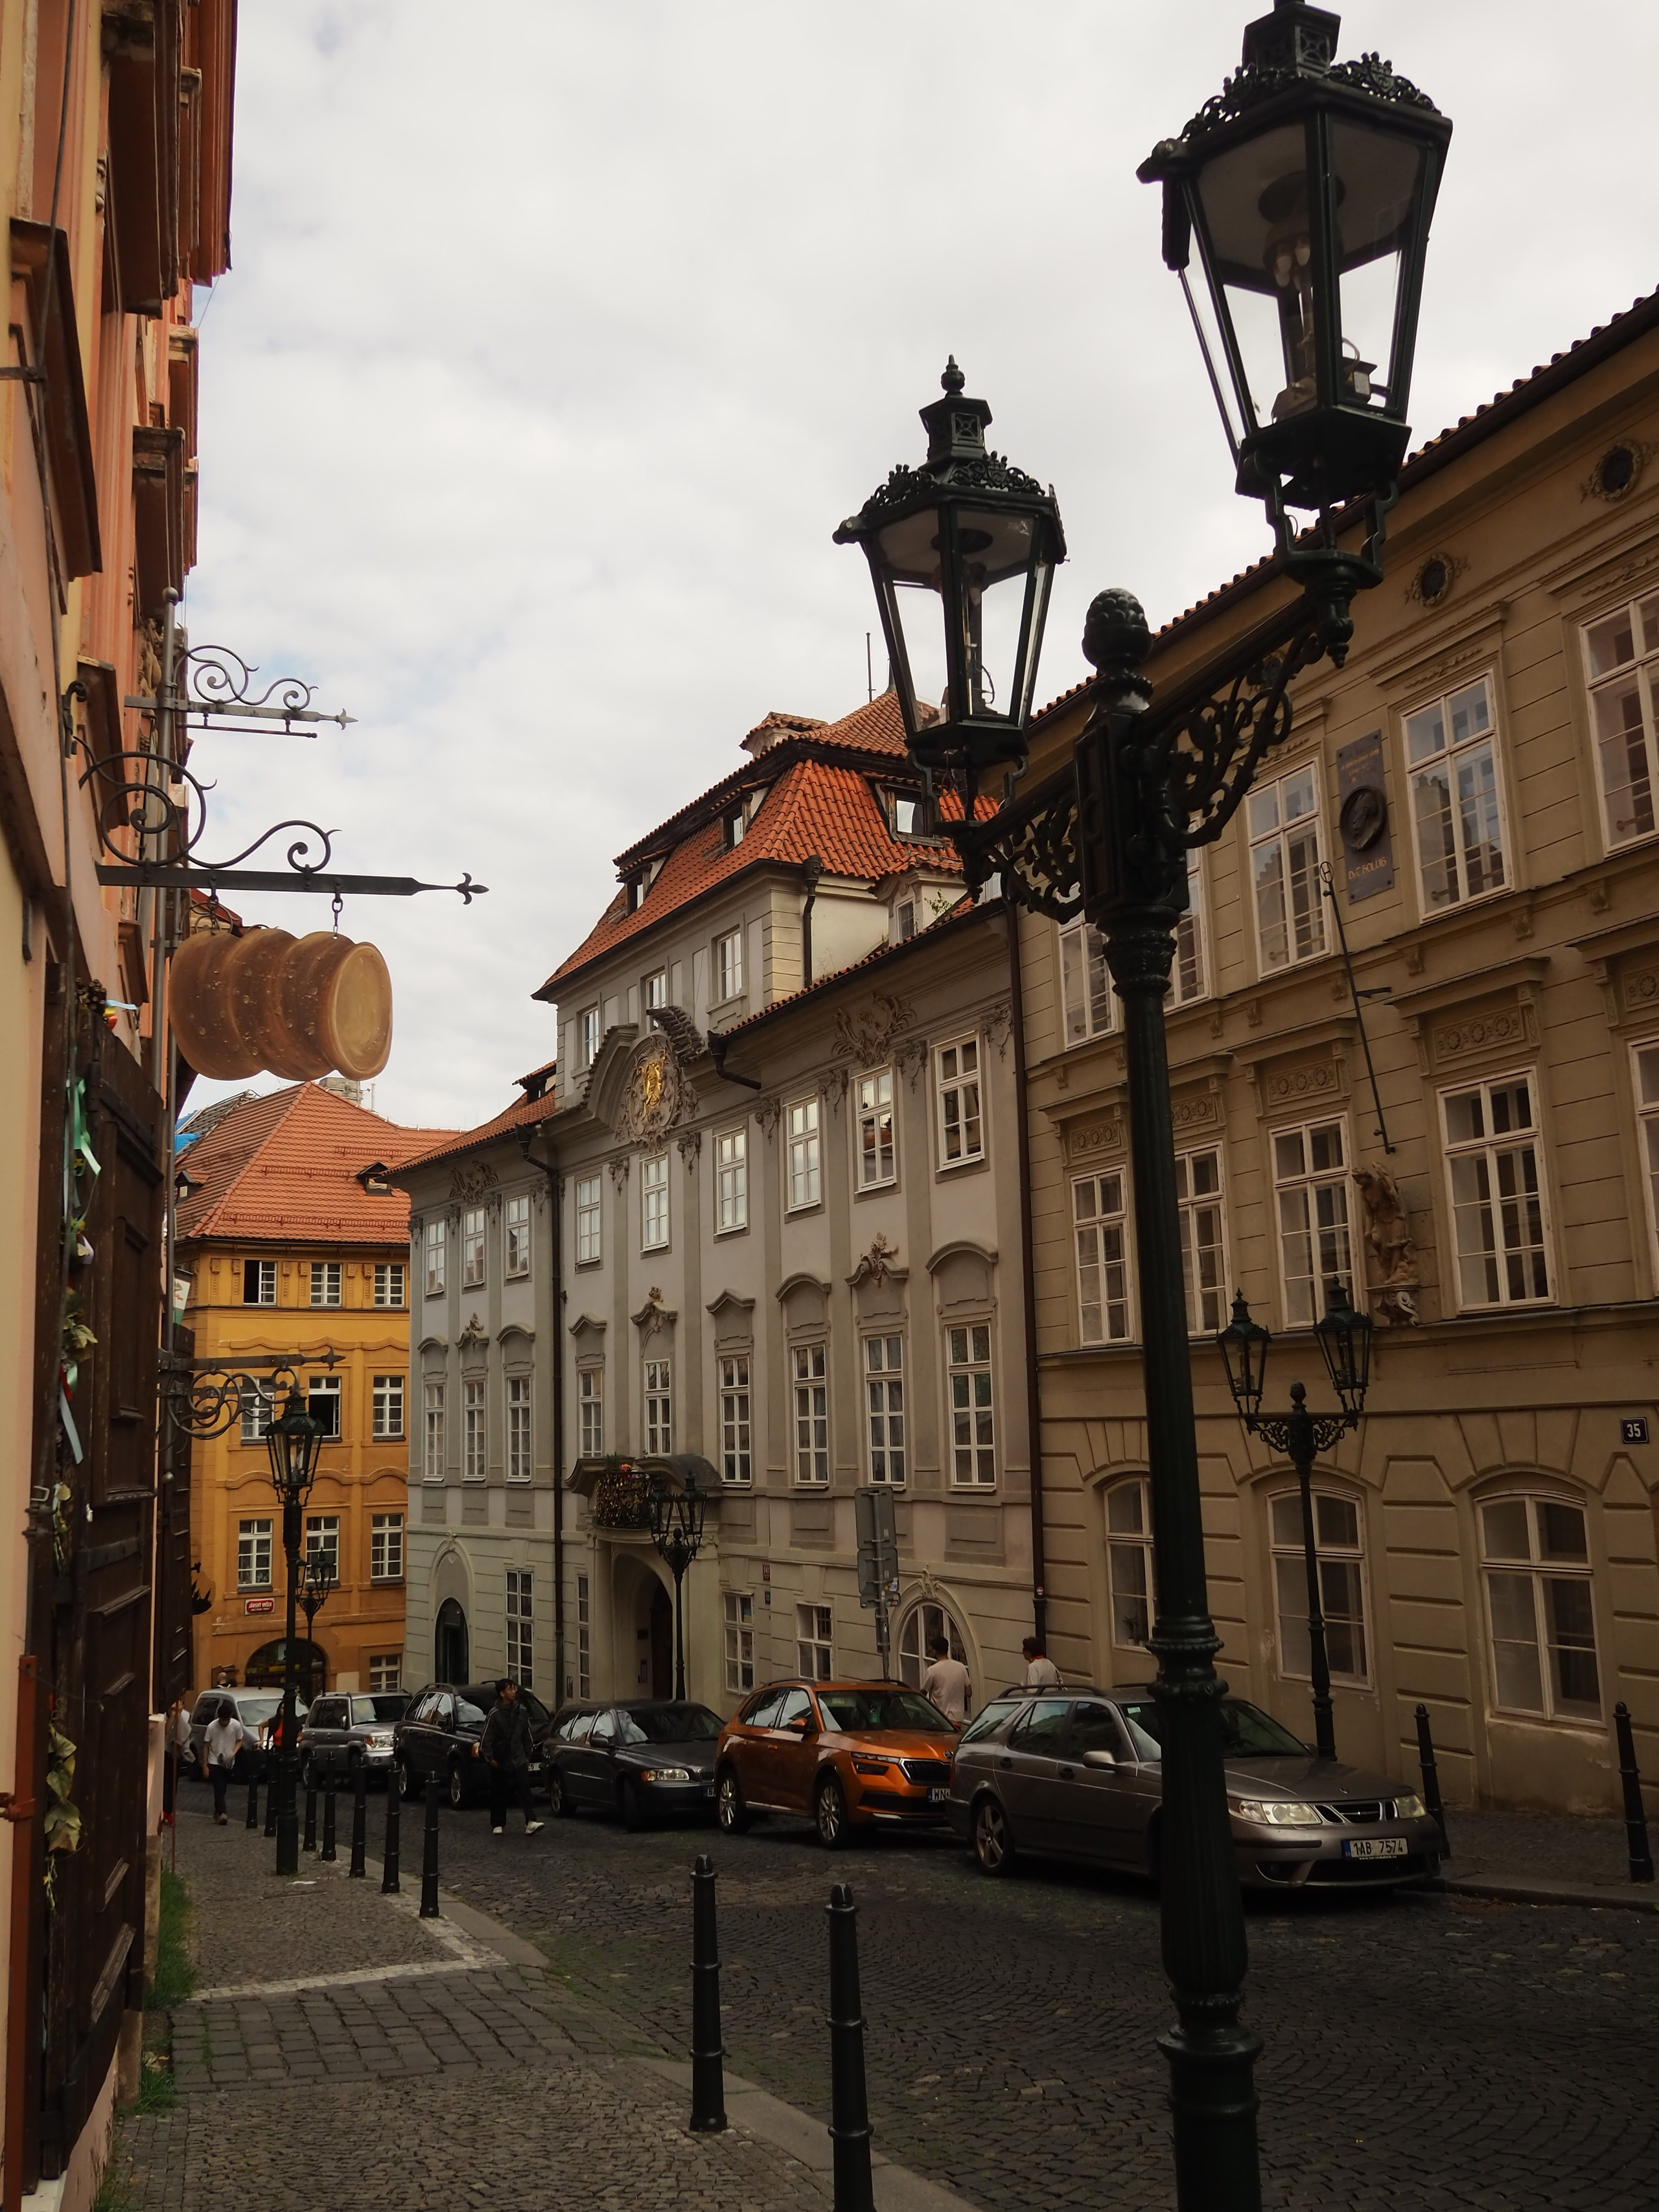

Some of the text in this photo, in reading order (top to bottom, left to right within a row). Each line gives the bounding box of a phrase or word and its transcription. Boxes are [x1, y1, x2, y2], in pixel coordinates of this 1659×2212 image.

[1627, 1423, 1641, 1438] 35
[1353, 1839, 1403, 1856] 1AB 7574
